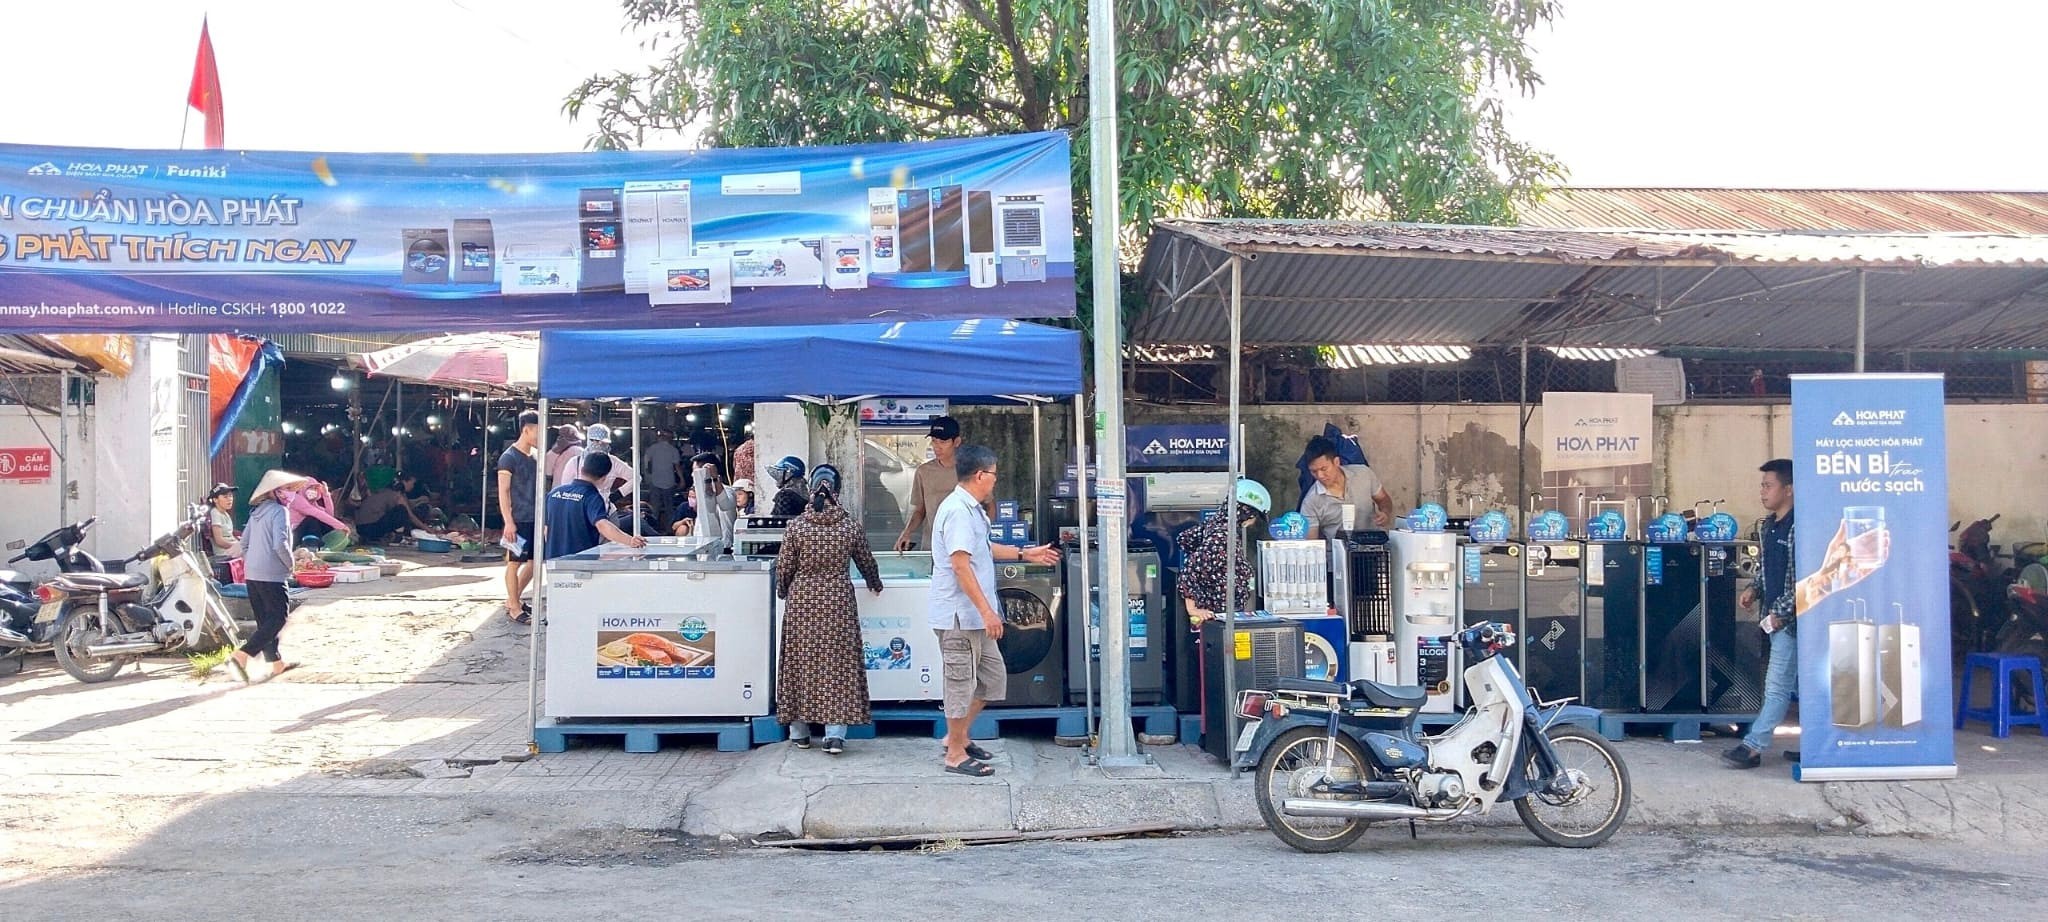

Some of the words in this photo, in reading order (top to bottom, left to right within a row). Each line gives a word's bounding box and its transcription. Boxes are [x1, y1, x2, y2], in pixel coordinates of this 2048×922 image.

[168, 165, 226, 178] Funiki
[20, 188, 138, 224] CHUẨN
[145, 194, 219, 226] HÒA
[222, 194, 302, 226] PHÁT
[16, 226, 114, 264] PHÁT
[120, 231, 238, 263] THÍCH
[246, 238, 356, 265] NGAY
[168, 302, 218, 316] Hotline
[221, 302, 266, 316] CSKH:
[270, 302, 306, 315] 1800
[310, 302, 346, 315] 1022
[1816, 437, 1834, 448] MÁY
[1836, 439, 1854, 448] LỌC
[1889, 460, 1923, 478] trao
[1840, 478, 1881, 492] nước
[1884, 478, 1924, 496] sạch
[1420, 658, 1426, 666] 3
